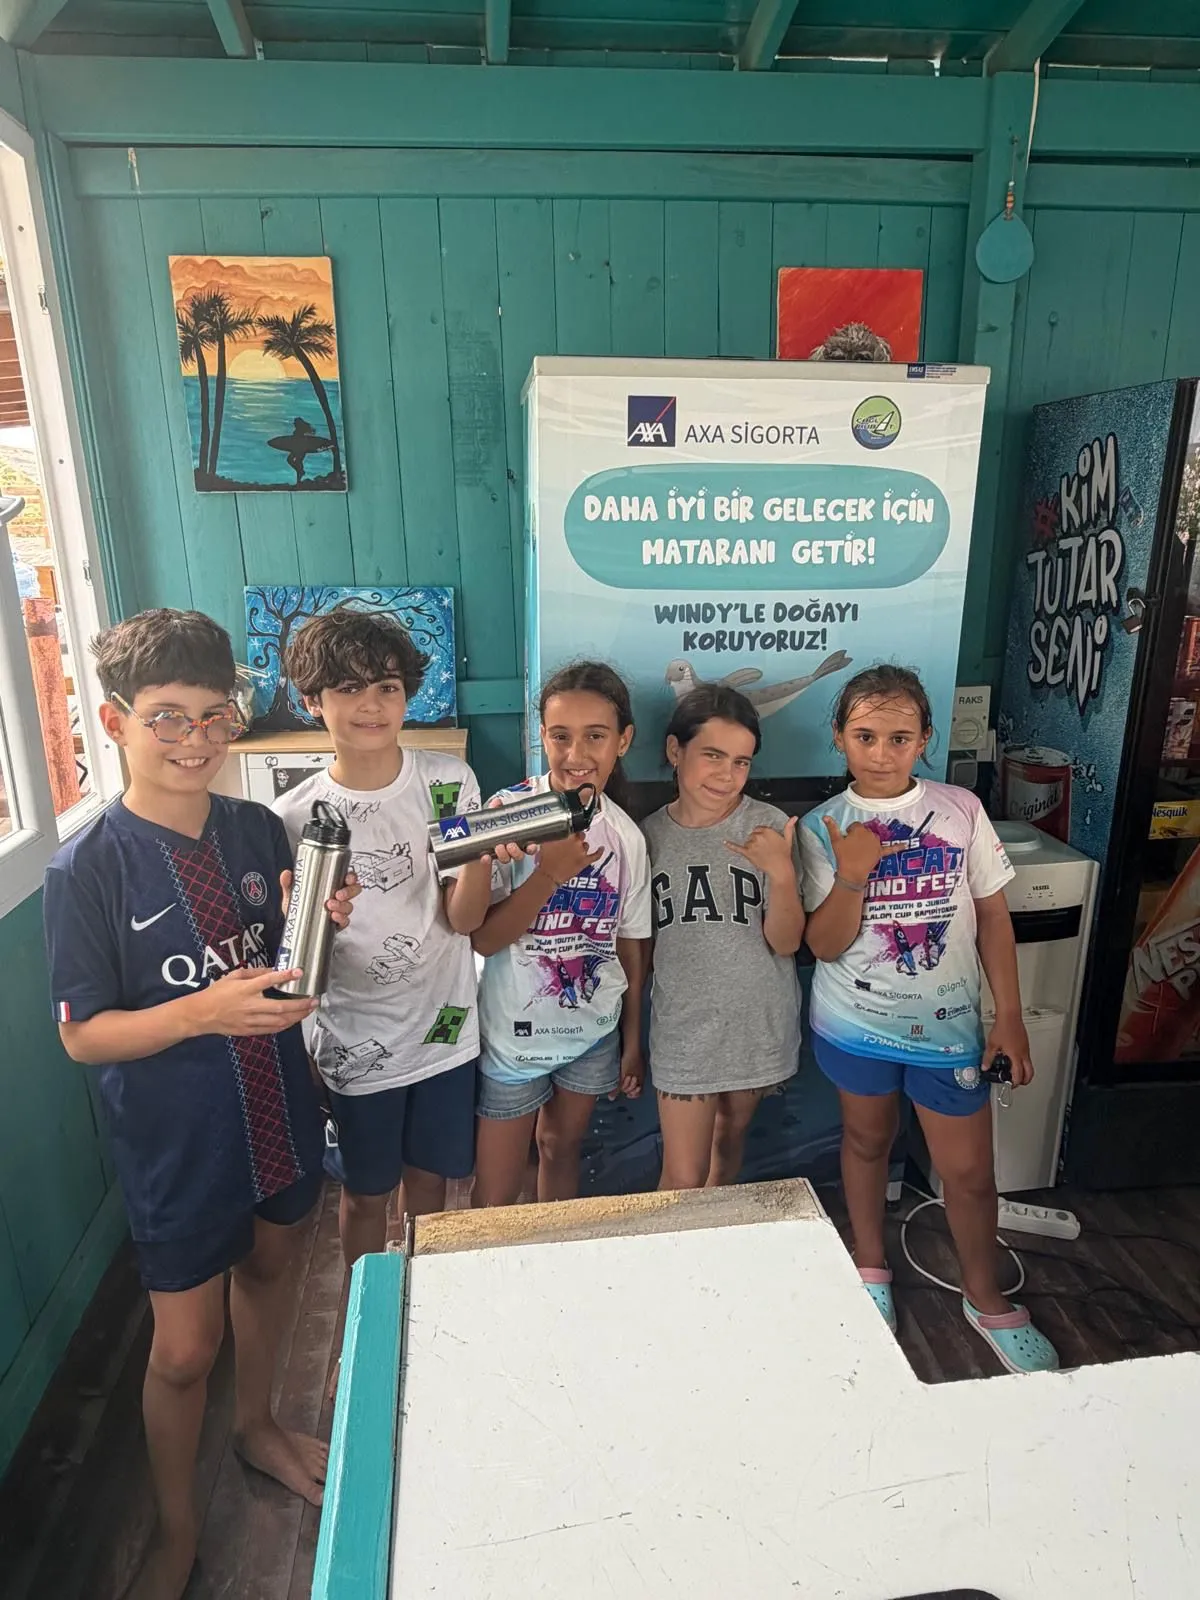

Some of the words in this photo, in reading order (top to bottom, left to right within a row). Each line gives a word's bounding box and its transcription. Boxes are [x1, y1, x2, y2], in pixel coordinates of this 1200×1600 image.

[627, 422, 667, 443] AXA
[685, 425, 725, 443] AXA
[730, 420, 820, 445] SİGORTA
[584, 494, 659, 522] DAHA
[667, 487, 706, 521] İYİ
[713, 487, 754, 523] BİR
[763, 496, 875, 523] GELECEK
[882, 488, 934, 525] İÇİN
[642, 537, 776, 566] MATARANI
[791, 531, 875, 566] GETİR!
[1027, 530, 1124, 613] TUTAR
[773, 598, 858, 623] DOĞAYI
[683, 627, 828, 653] KORUYORUZ!
[958, 695, 983, 706] RAKS
[1010, 787, 1058, 821] Original
[443, 826, 467, 841] AXA
[475, 820, 498, 833] AXA
[651, 863, 762, 930] GAP
[865, 878, 907, 898] IND
[889, 902, 914, 910] YOUTH
[894, 911, 911, 919] CUP
[285, 917, 297, 943] AXA
[534, 912, 575, 931] IND
[161, 922, 265, 988] QATAR
[534, 1027, 549, 1036] AXA
